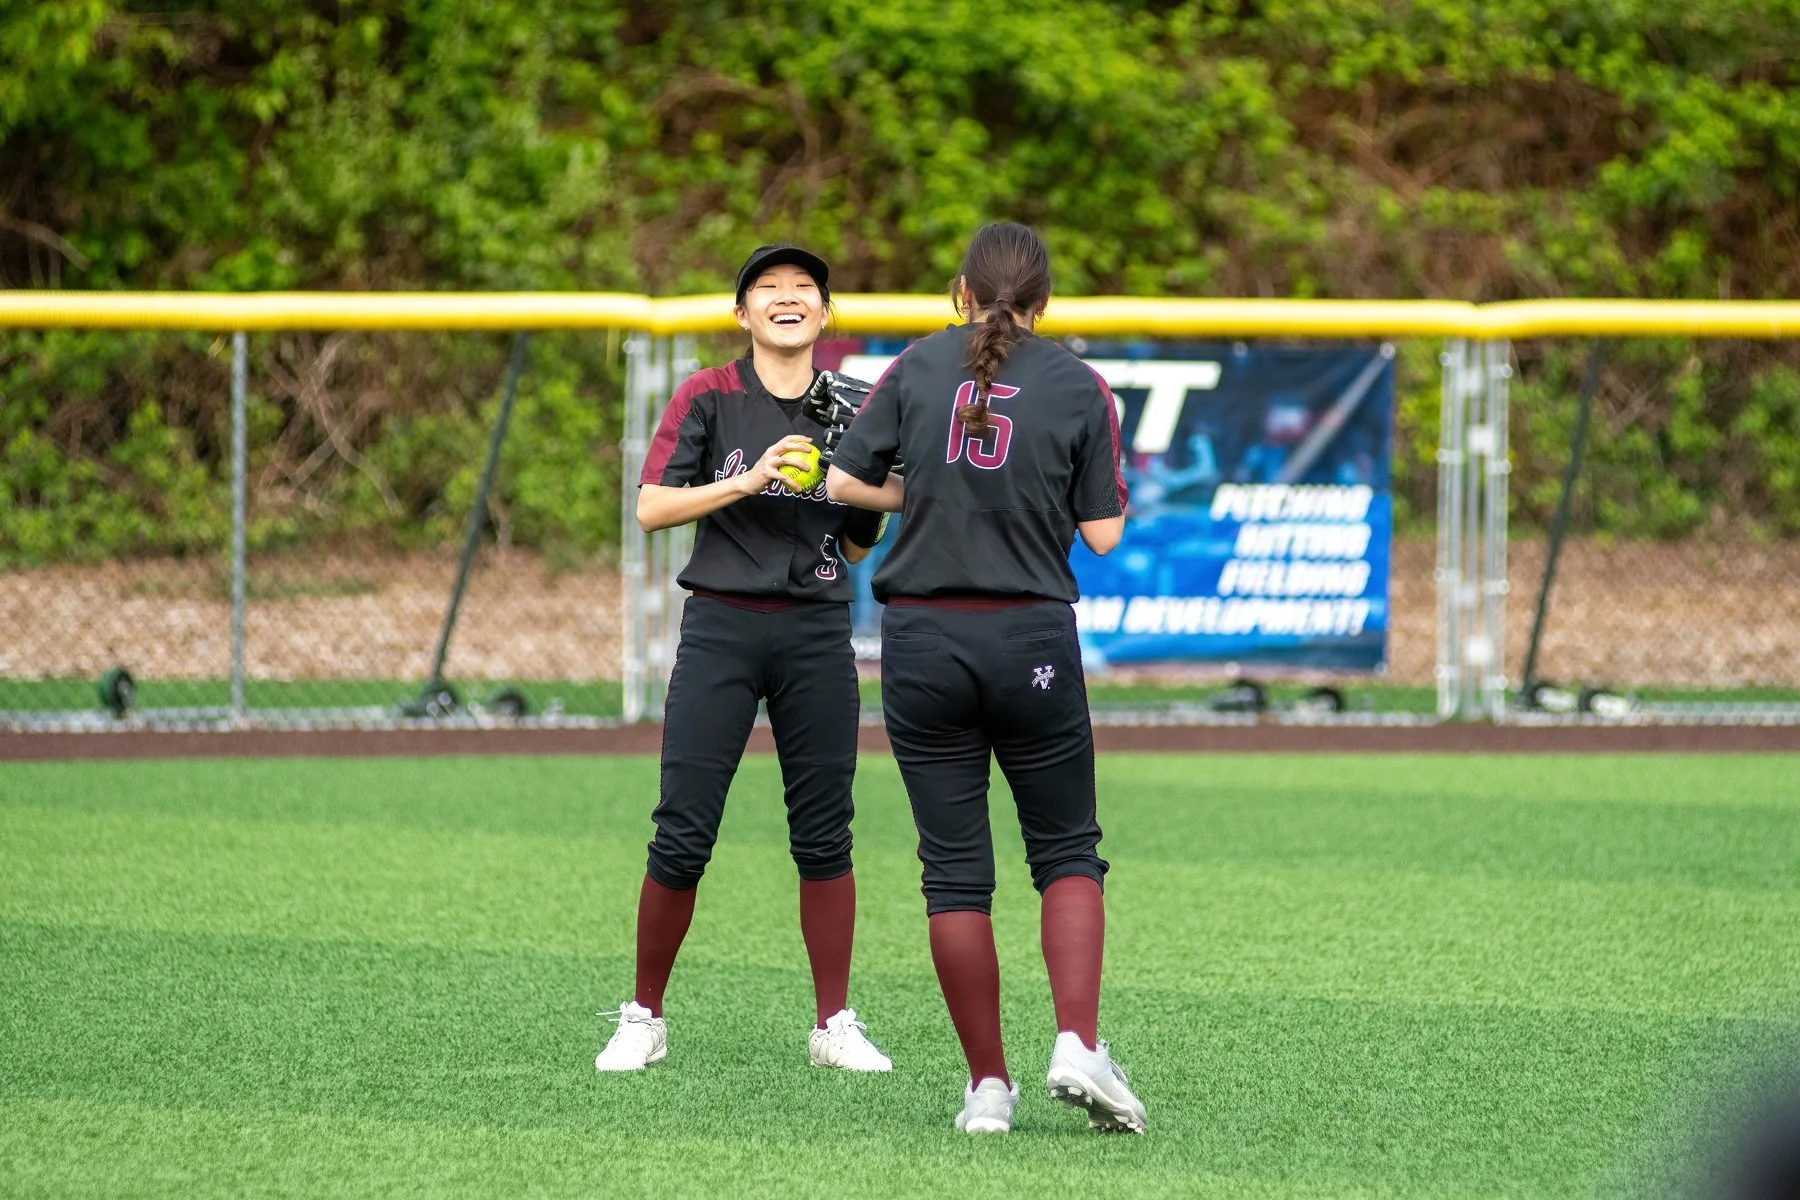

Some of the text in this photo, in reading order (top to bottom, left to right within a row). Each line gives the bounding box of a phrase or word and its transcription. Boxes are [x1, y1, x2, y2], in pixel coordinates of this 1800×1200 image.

[946, 380, 1021, 470] 15
[1210, 484, 1373, 521] PITCHING
[1234, 522, 1372, 559] HITTING
[1217, 559, 1371, 596] FIELDING
[1122, 595, 1371, 635] DEVELOPMENT!
